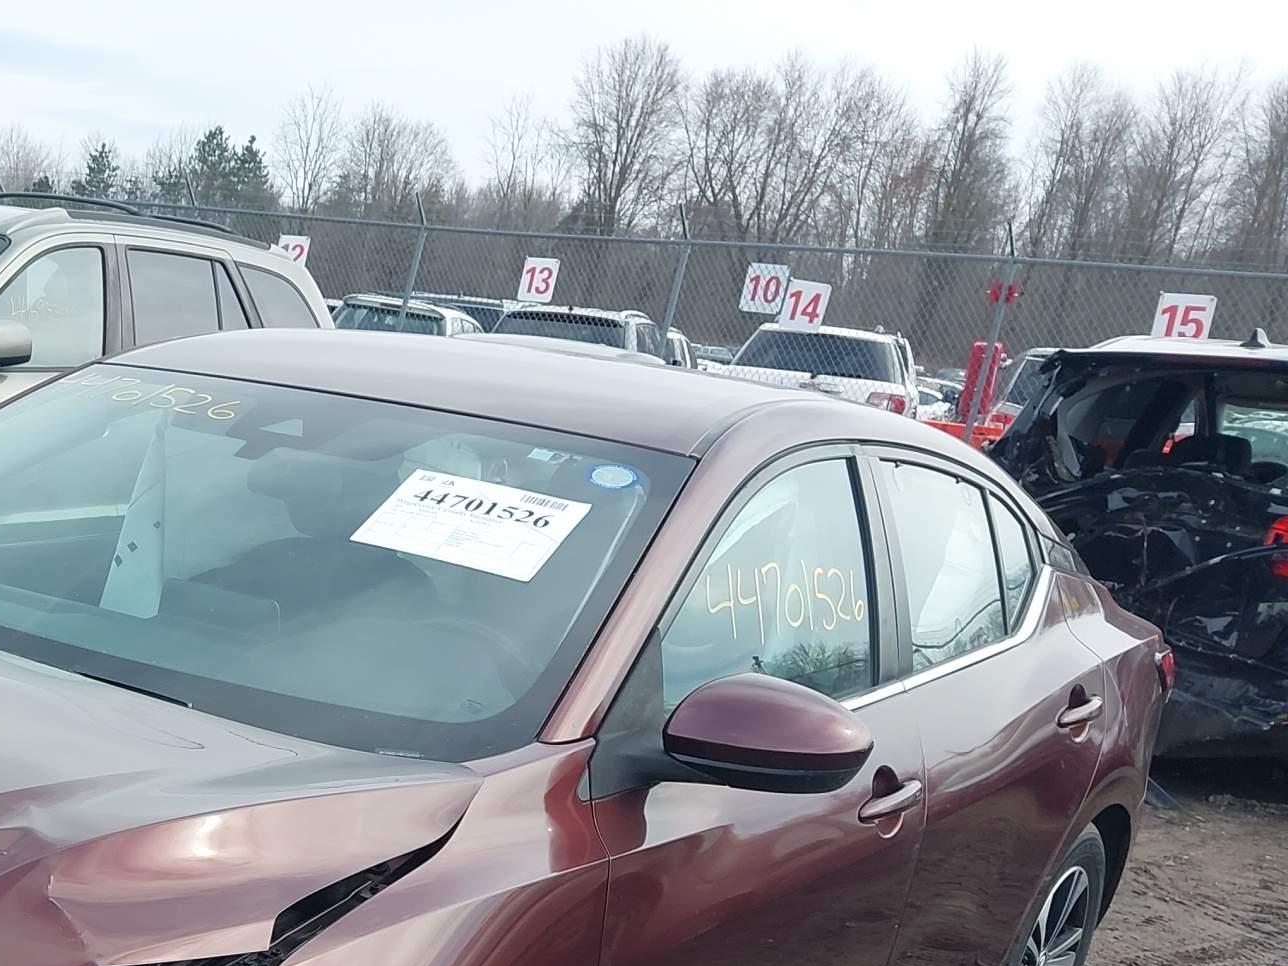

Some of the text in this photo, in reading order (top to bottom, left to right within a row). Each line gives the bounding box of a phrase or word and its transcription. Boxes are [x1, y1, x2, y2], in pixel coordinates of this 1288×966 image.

[525, 265, 554, 296] 13
[748, 274, 782, 304] 10
[788, 289, 824, 325] 14
[1161, 304, 1207, 339] 15
[412, 488, 556, 530] 44701526
[705, 559, 865, 645] 44701526
